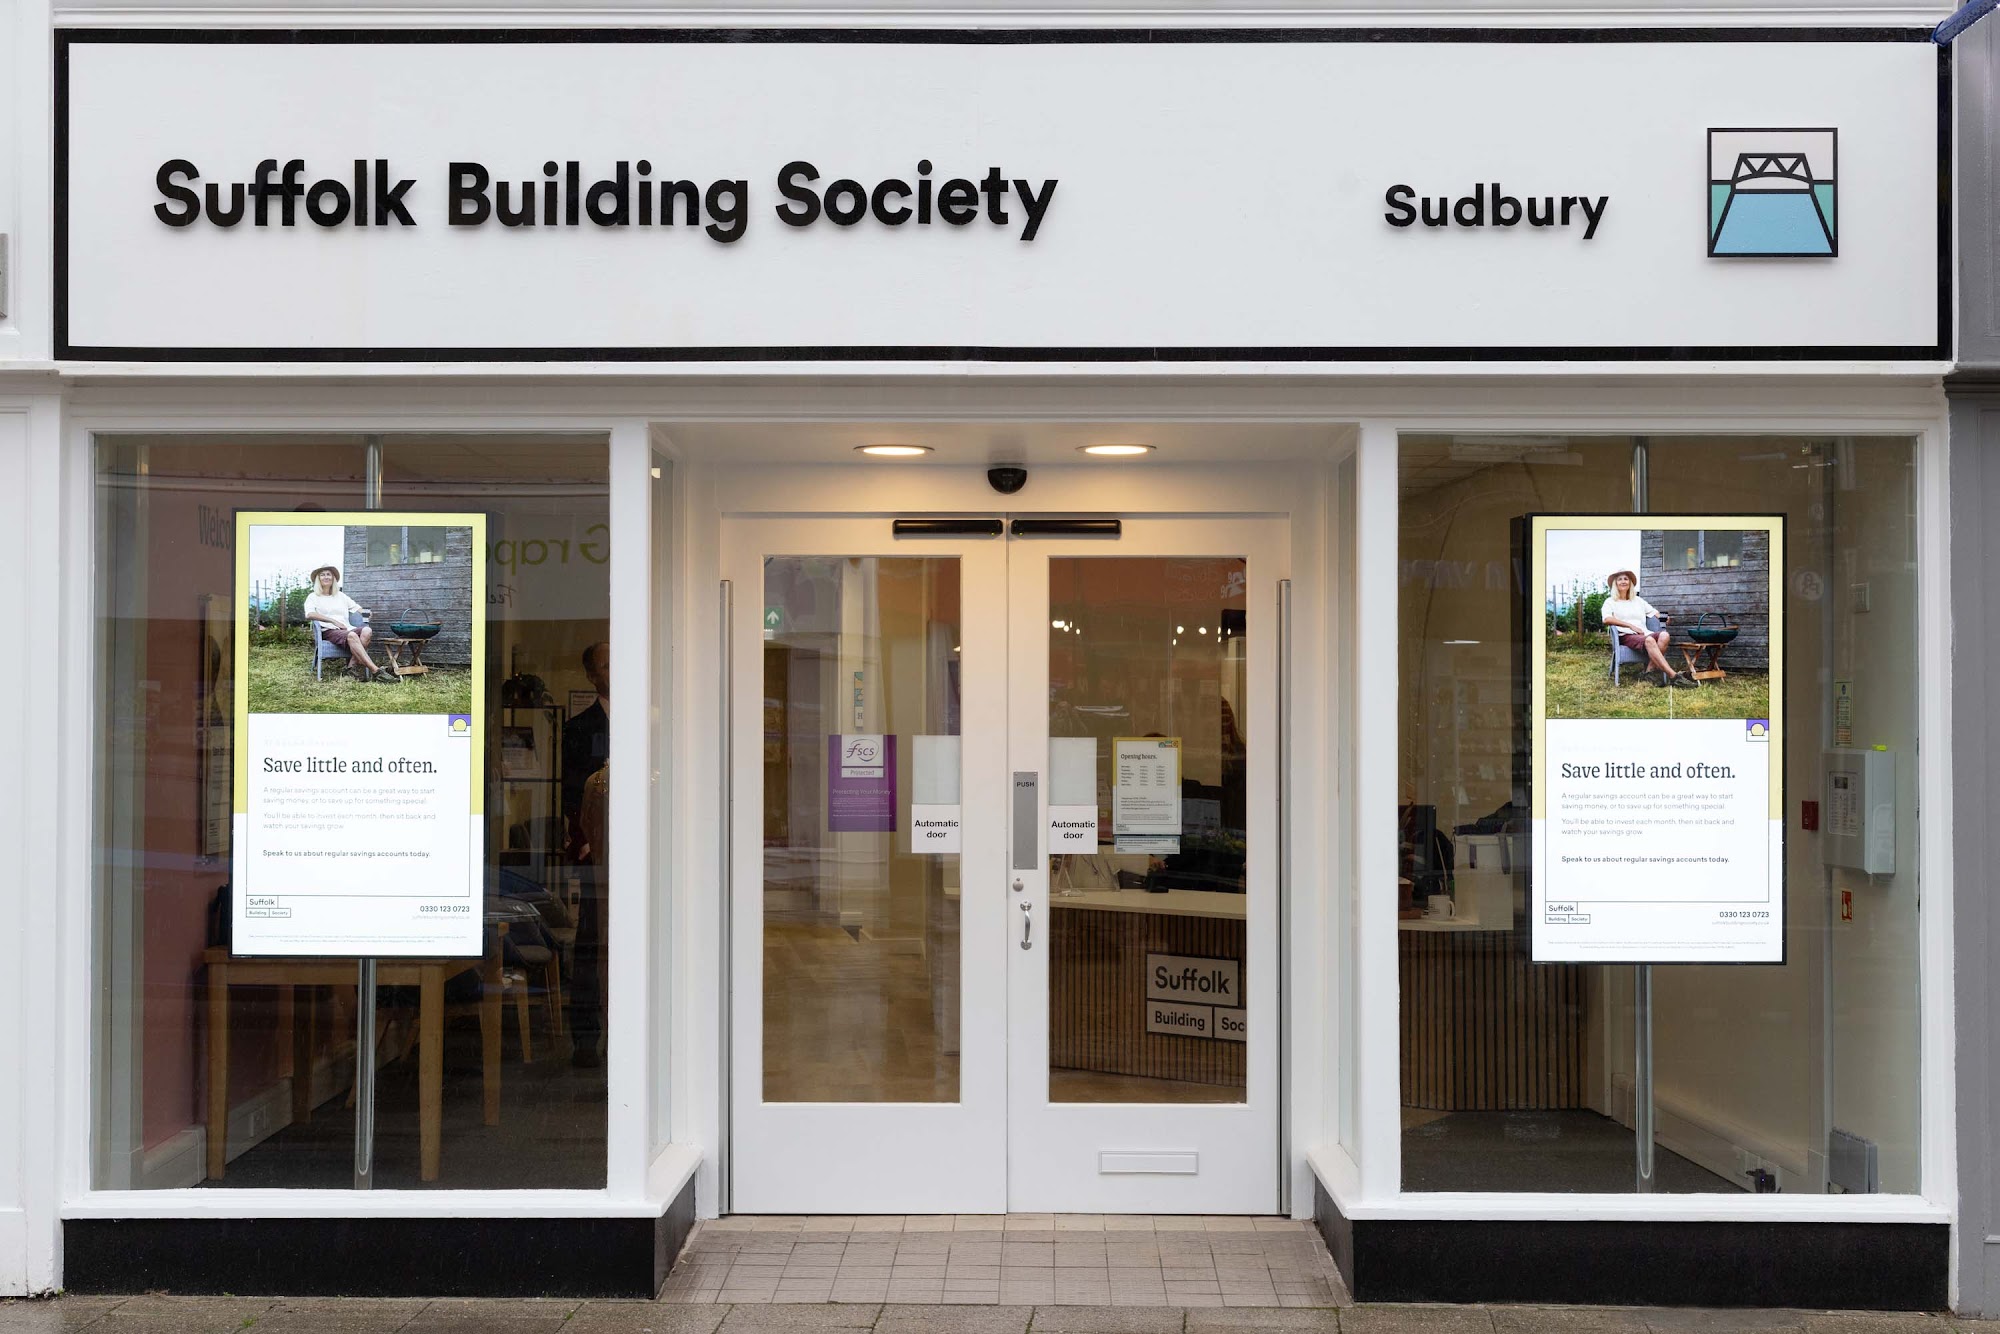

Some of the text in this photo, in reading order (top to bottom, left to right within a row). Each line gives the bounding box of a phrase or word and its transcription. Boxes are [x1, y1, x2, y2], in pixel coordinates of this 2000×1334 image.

[154, 159, 1058, 243] Suffolk Building Society
[1385, 183, 1609, 239] Sudbury
[263, 757, 437, 773] Save little and often.
[1562, 762, 1736, 779] Save little and often.
[270, 787, 293, 795] regular
[379, 787, 396, 795] great
[263, 797, 284, 805] saving
[365, 797, 400, 805] something
[1561, 792, 1567, 800] A
[1568, 792, 1591, 801] regular
[1593, 792, 1617, 801] savings
[1619, 792, 1646, 800] account
[1662, 792, 1670, 800] be
[1677, 792, 1694, 801] great
[1710, 792, 1717, 800] to
[1719, 792, 1733, 800] start
[1561, 802, 1583, 811] saving
[1643, 803, 1652, 811] up
[1664, 802, 1699, 811] something
[292, 812, 306, 820] able
[337, 812, 353, 820] each
[380, 812, 395, 820] then
[406, 812, 421, 820] back
[423, 812, 436, 820] and
[285, 823, 299, 831] your
[301, 822, 325, 831] savings
[914, 819, 959, 828] Automatic
[1051, 820, 1096, 829] Automatic
[926, 831, 948, 839] door
[1063, 831, 1084, 840] door
[1599, 828, 1624, 836] savings
[262, 849, 284, 858] Speak
[286, 849, 293, 857] to
[304, 849, 323, 857] about
[325, 849, 349, 858] regular
[350, 849, 375, 858] savings
[377, 849, 408, 857] accounts
[410, 849, 430, 858] today.
[1561, 855, 1583, 864] Speak
[1624, 855, 1647, 864] regular
[1649, 855, 1675, 864] savings
[1709, 855, 1730, 864] today.
[249, 898, 276, 906] Suffolk
[419, 905, 470, 913] 0330 123 0723
[1548, 904, 1575, 912] Suffolk
[1155, 966, 1231, 995] Suffolk
[1155, 1010, 1245, 1032] Building Soc
